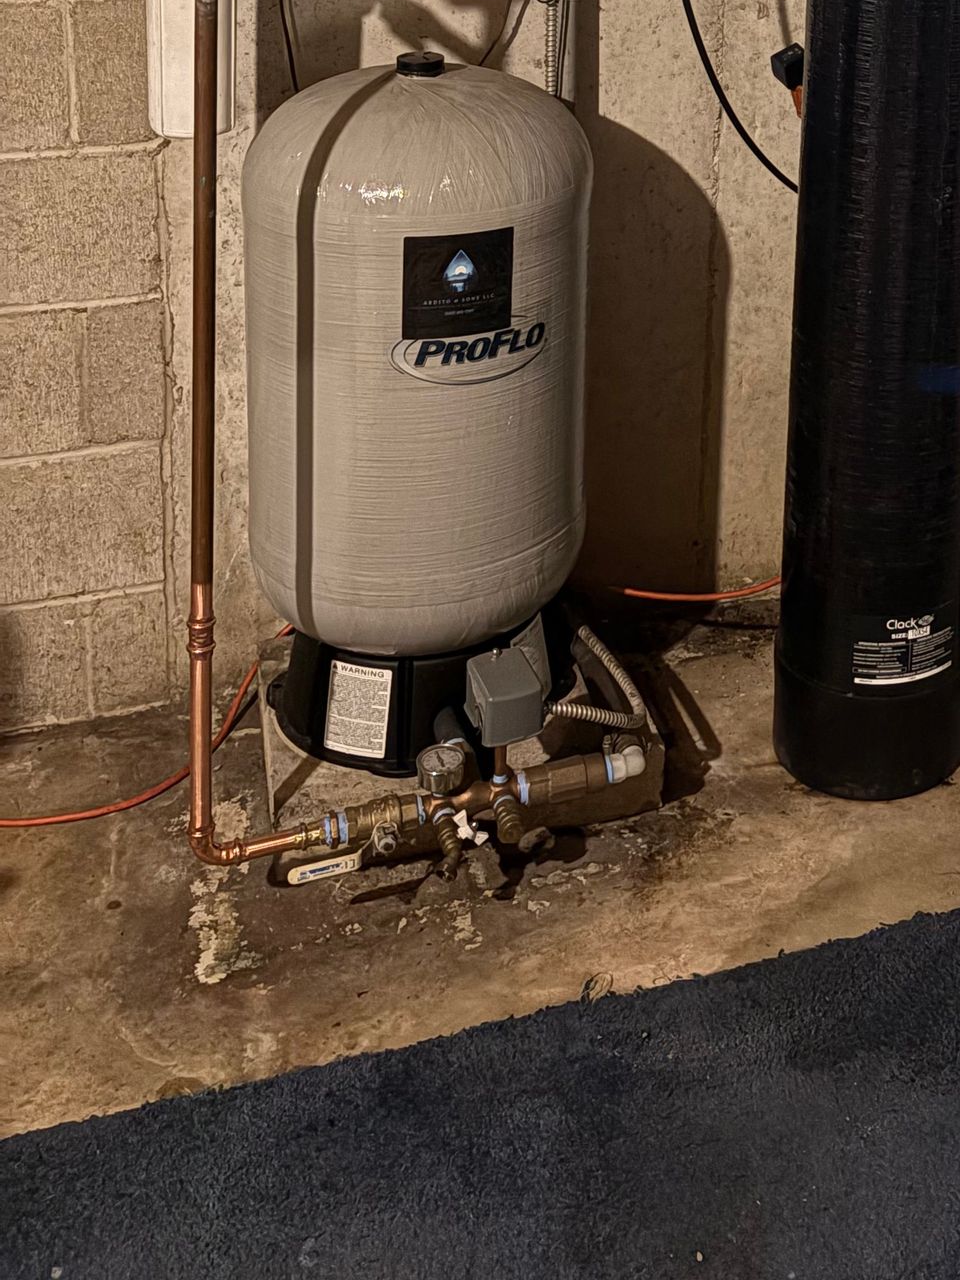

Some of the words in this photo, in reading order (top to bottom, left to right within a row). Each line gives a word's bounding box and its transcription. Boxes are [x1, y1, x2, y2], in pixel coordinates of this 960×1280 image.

[414, 322, 546, 367] PROFLO
[886, 617, 919, 630] Clack
[340, 664, 385, 678] WARNING
